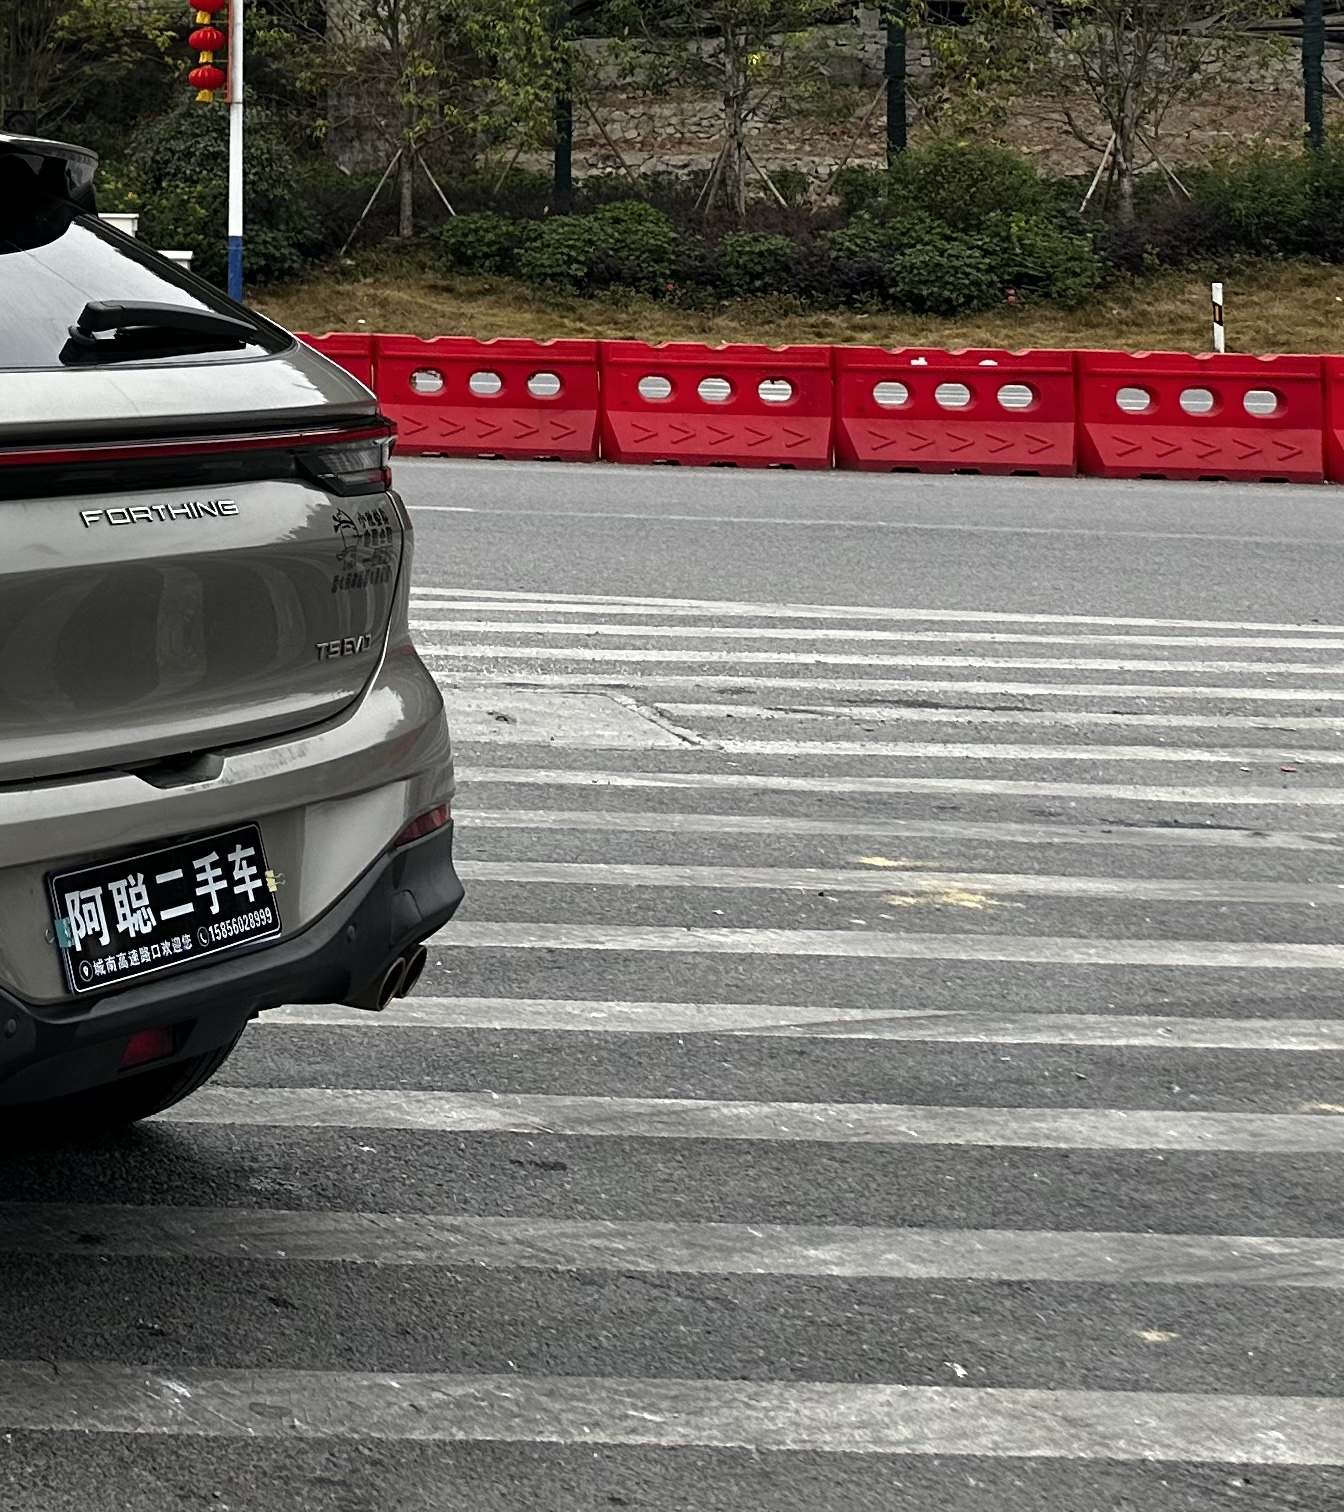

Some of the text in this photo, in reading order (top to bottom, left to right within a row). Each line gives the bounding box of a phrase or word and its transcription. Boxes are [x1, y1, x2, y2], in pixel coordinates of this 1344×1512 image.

[80, 500, 240, 528] FORTHING
[64, 844, 263, 952] 阿聪二手车
[92, 906, 273, 977] 城南高速路口欢迎您 15856028999
